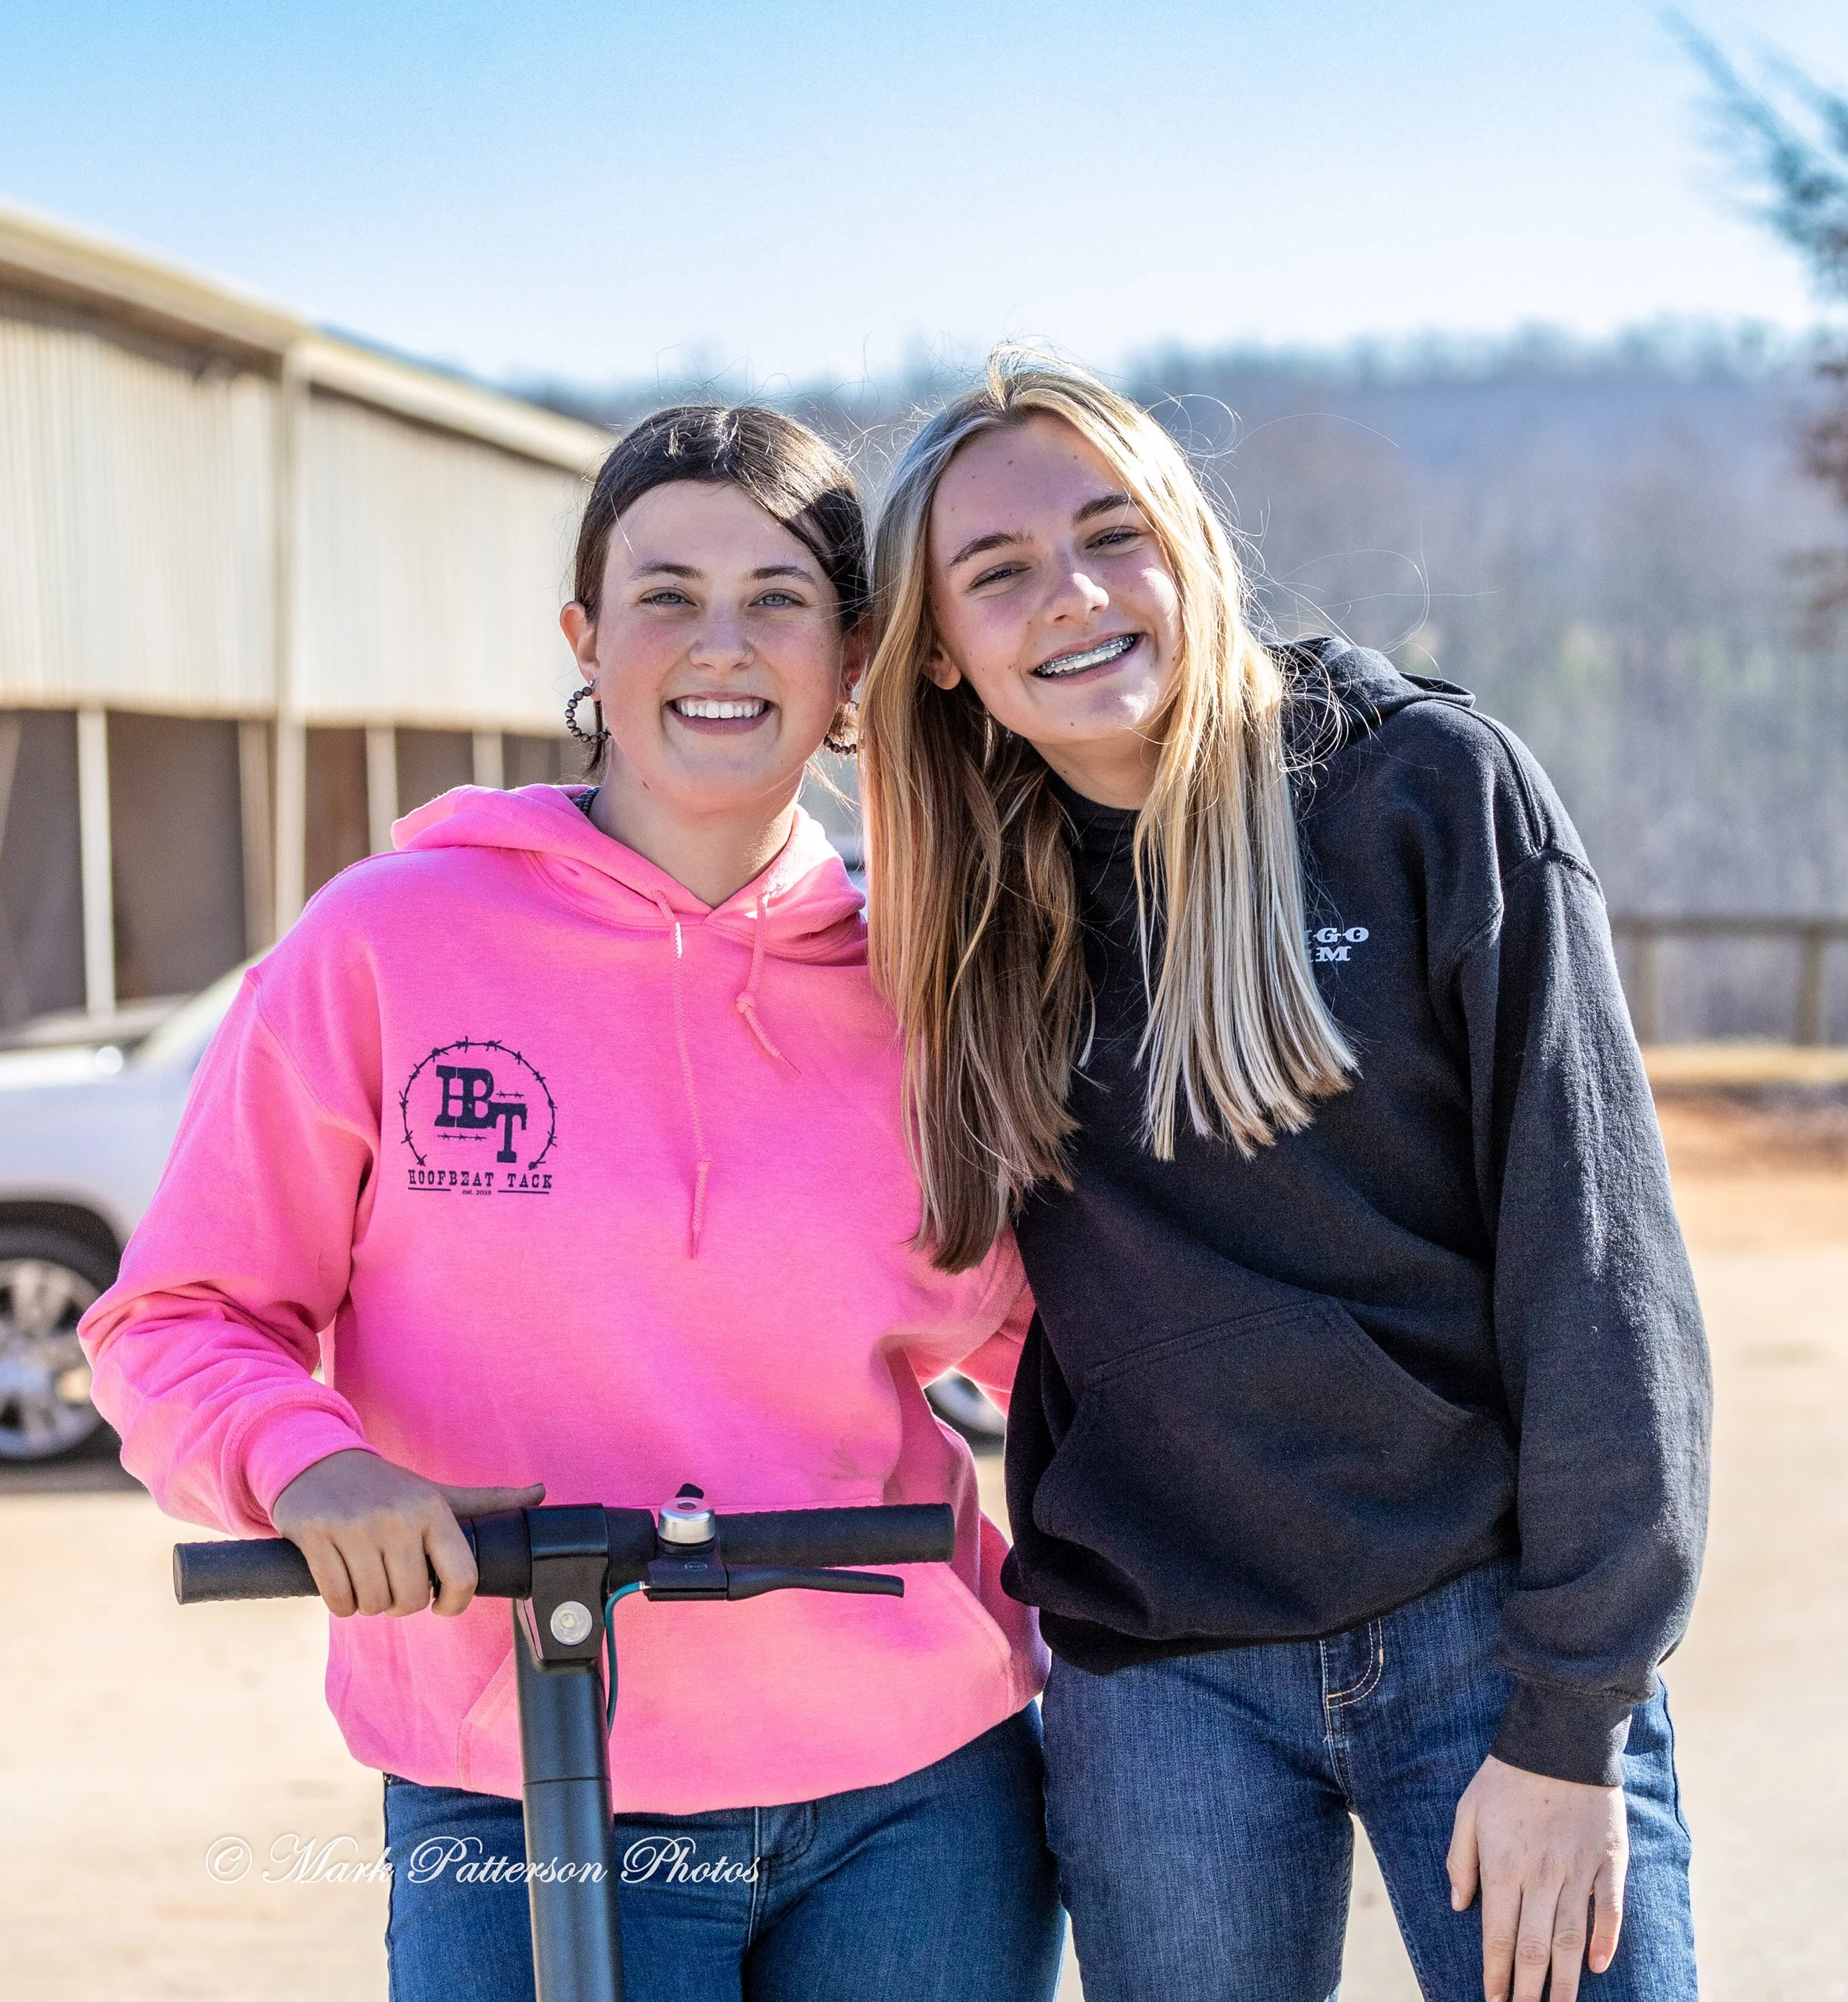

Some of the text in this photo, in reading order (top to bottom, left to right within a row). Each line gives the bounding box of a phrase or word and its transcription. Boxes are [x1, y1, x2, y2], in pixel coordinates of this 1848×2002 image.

[1307, 946, 1352, 963] M
[407, 1169, 553, 1189] HOOFBEAT TACK
